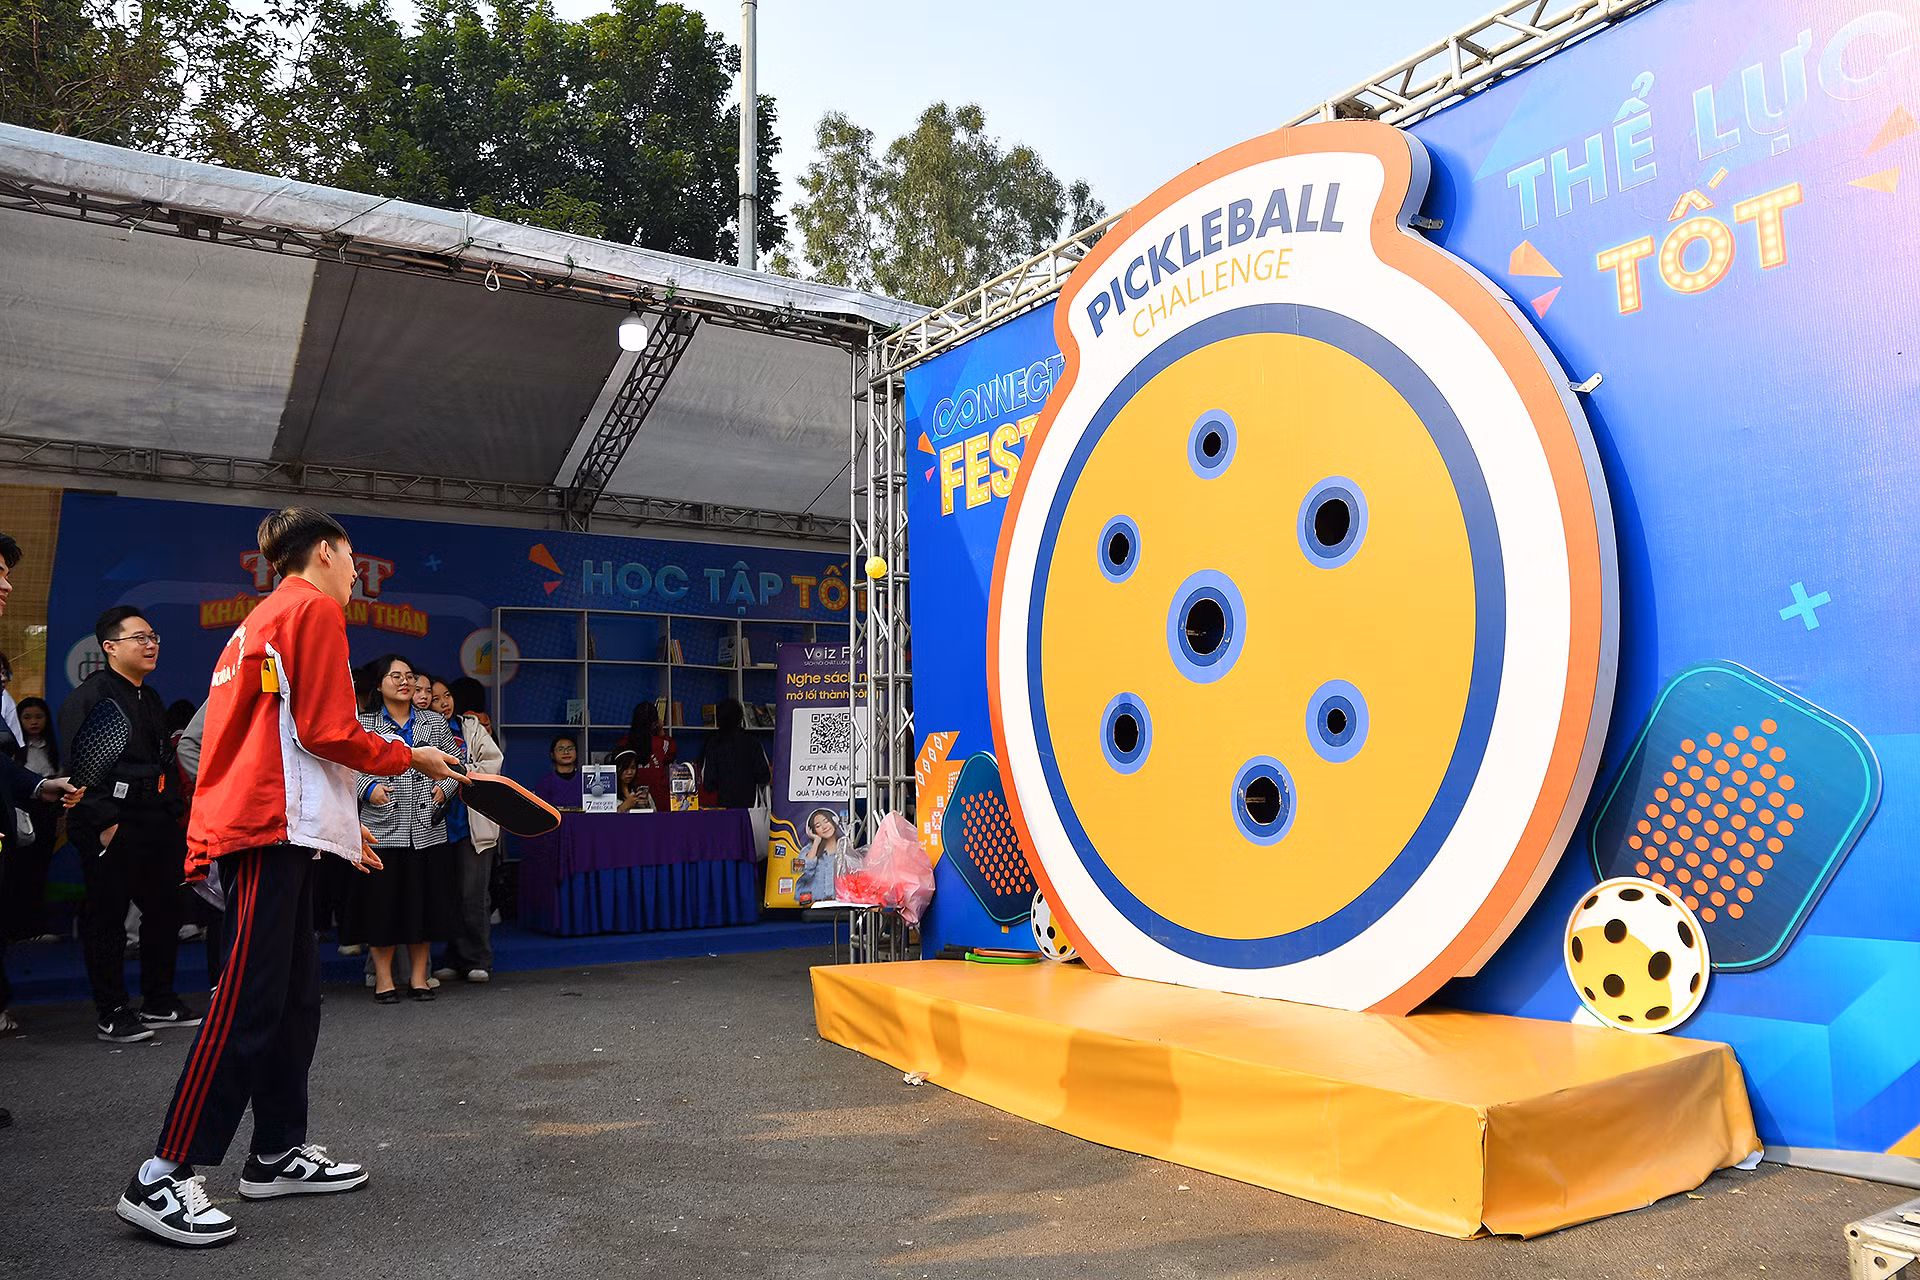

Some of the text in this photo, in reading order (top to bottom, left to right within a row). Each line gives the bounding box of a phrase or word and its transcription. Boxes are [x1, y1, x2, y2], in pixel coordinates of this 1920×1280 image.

[1506, 10, 1912, 231] THỂ LỰC
[1086, 182, 1344, 338] PICKLEBALL
[1596, 167, 1804, 315] TỐT
[1132, 247, 1293, 338] CHALLENGE
[932, 352, 1067, 438] CONNECT
[582, 559, 690, 609] HỌC
[703, 560, 783, 615] TẬP
[373, 605, 428, 634] THÂN
[786, 673, 821, 688] Nghe
[804, 646, 836, 660] Voiz
[786, 690, 803, 700] mở
[806, 688, 817, 700] lối
[819, 689, 850, 700] thành
[807, 773, 850, 787] 7 NGÀY
